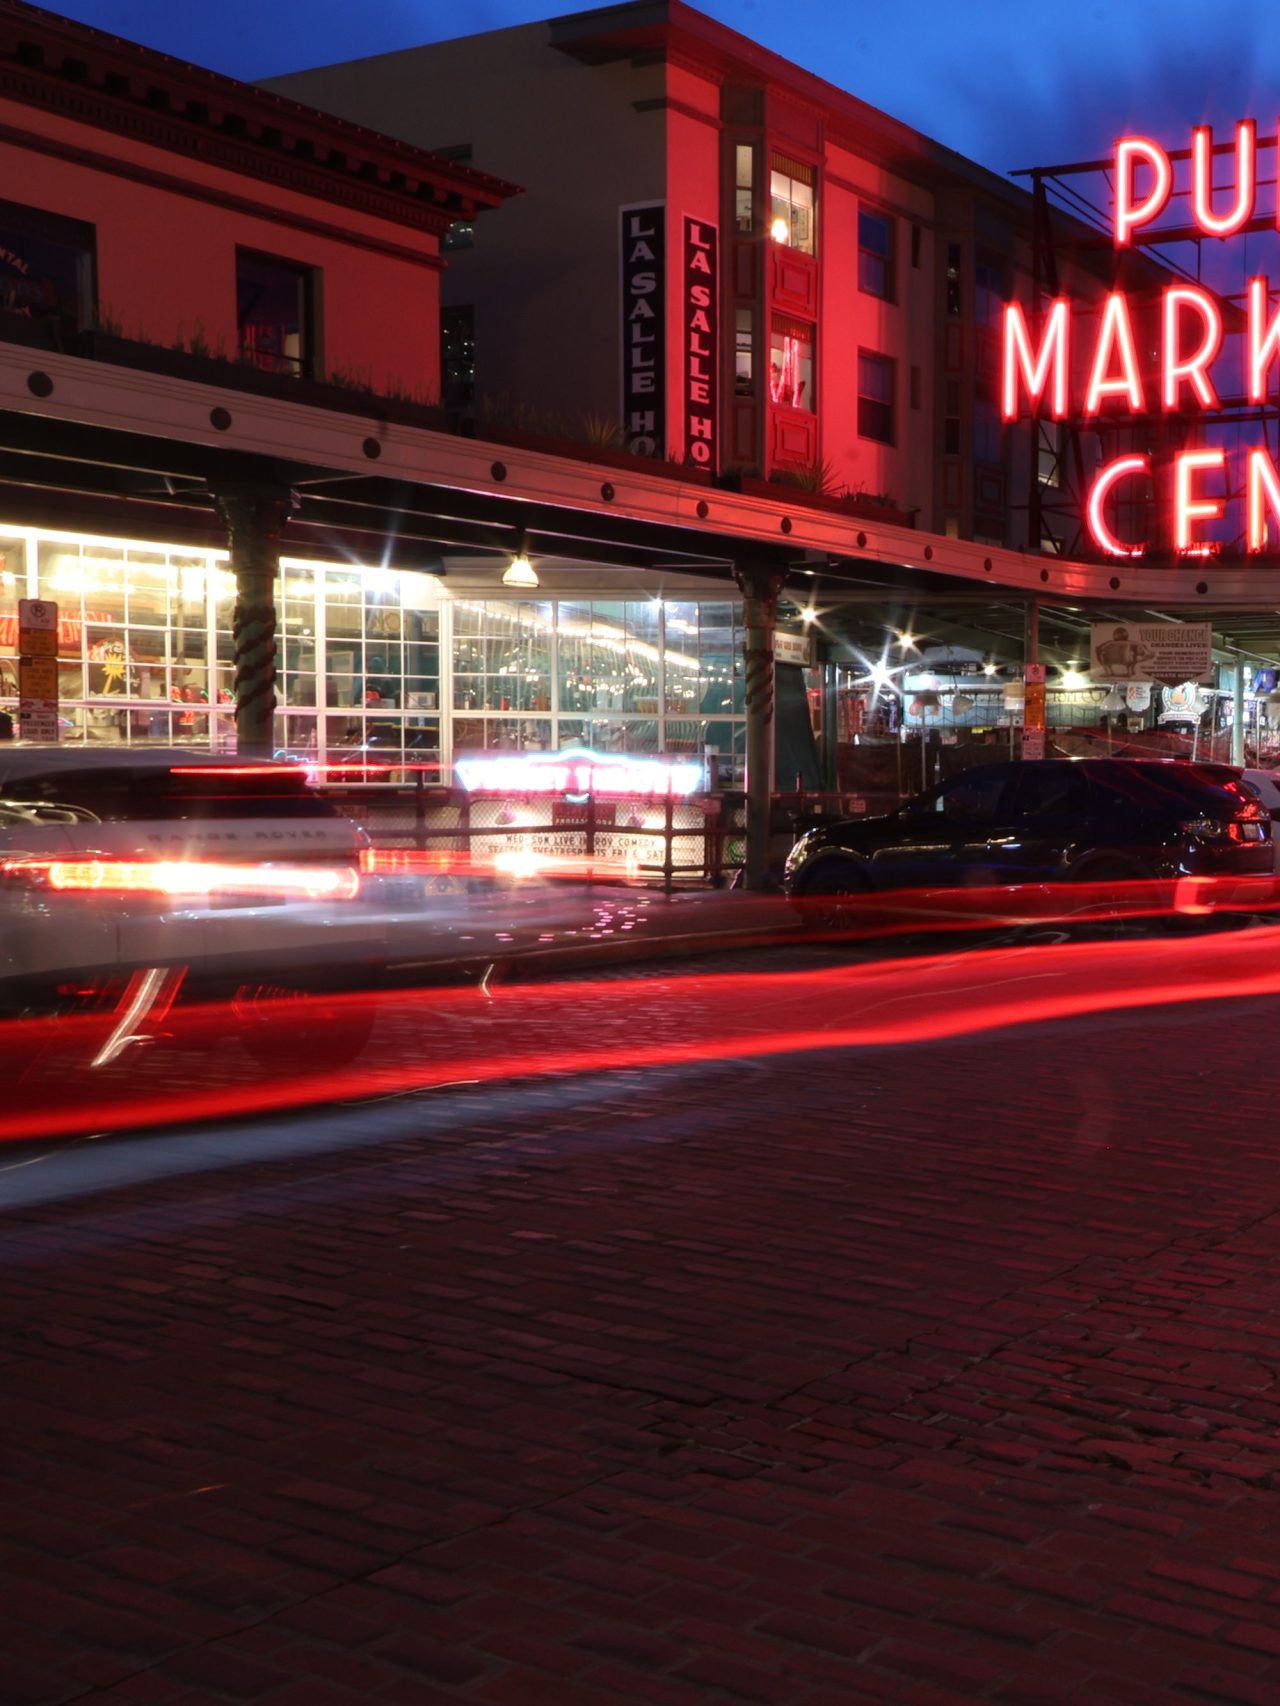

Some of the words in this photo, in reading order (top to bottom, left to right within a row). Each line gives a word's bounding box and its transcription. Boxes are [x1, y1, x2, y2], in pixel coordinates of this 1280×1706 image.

[629, 272, 657, 394] SALLE
[690, 285, 711, 405] SALLE
[631, 410, 656, 457] HO
[690, 415, 712, 471] HO
[1141, 629, 1166, 641] YOUR
